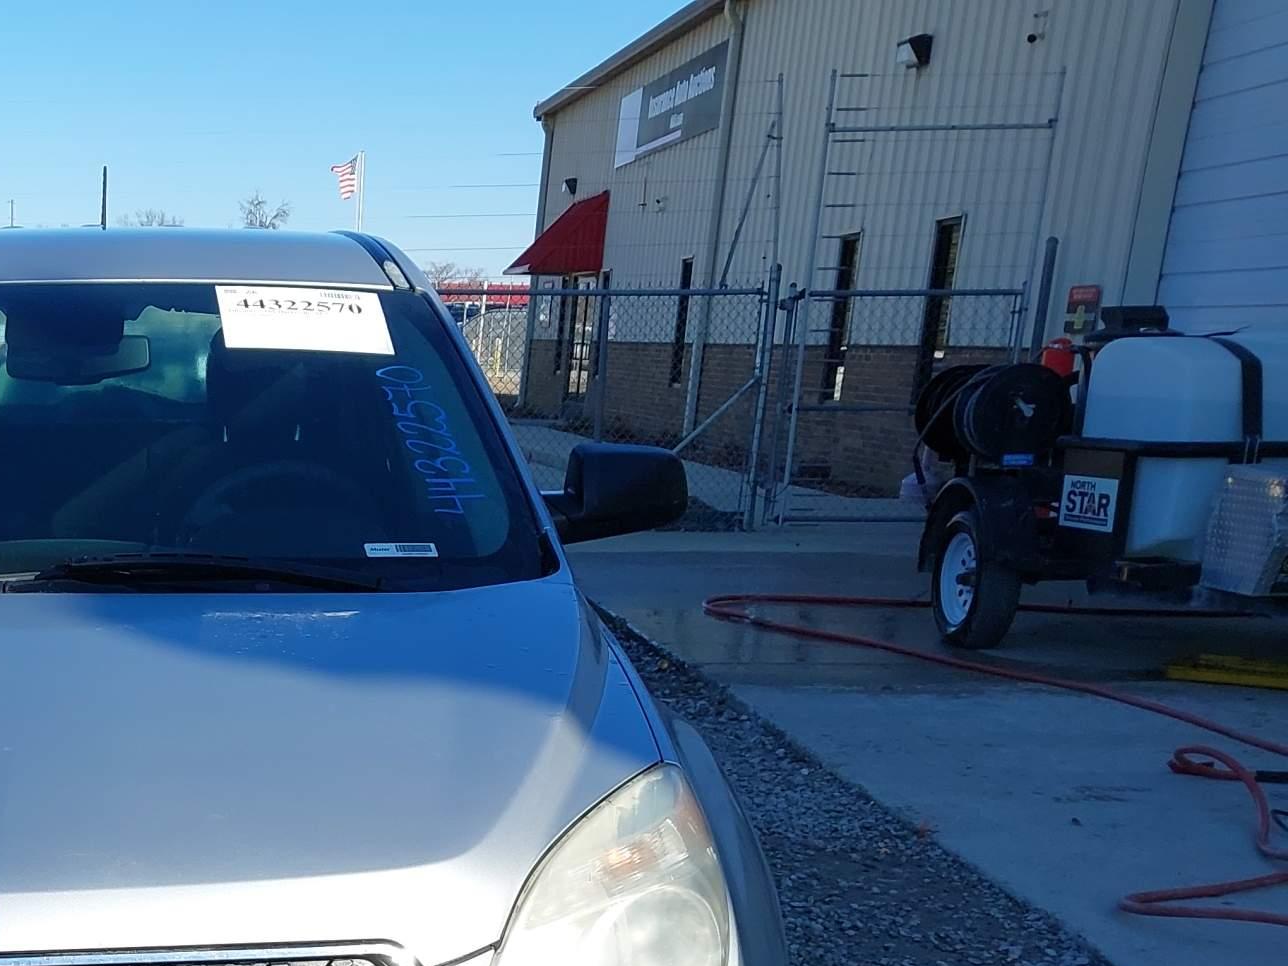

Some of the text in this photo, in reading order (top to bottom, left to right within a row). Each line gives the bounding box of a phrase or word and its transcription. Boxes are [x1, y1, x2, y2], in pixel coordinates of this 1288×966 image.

[236, 297, 363, 315] 44322570
[375, 365, 486, 514] 44322570
[1071, 480, 1097, 492] NORTH
[1065, 489, 1111, 517] STAR
